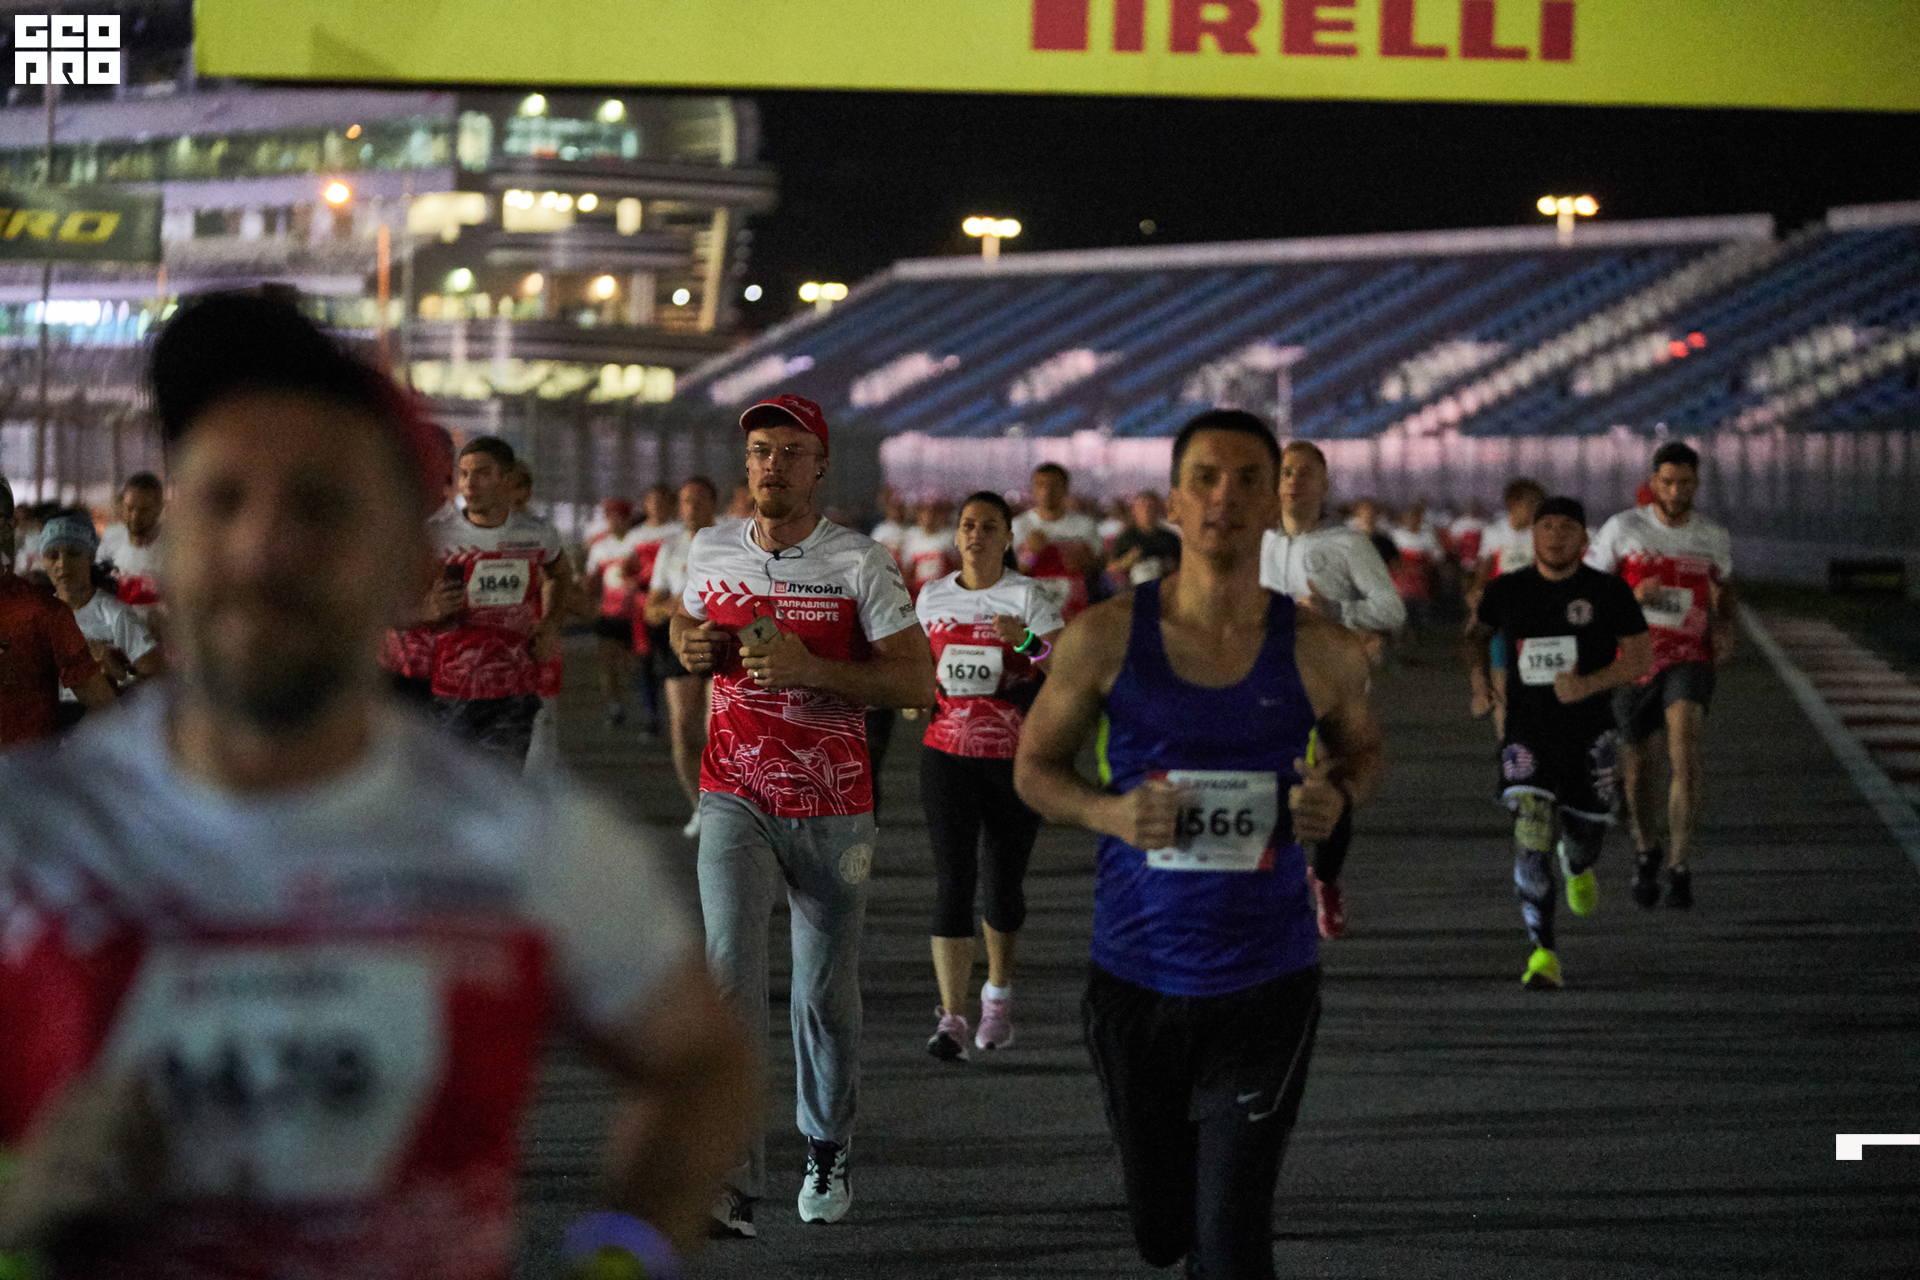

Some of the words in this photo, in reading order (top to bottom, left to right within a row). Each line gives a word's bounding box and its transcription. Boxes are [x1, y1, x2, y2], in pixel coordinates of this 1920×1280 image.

[1030, 0, 1576, 62] IRELLI
[479, 574, 520, 592] 1849
[788, 583, 842, 595] ЛУКОЙЛ
[777, 599, 839, 609] ЗАПРАВЛЯЕМ
[787, 609, 839, 621] СПОРТЕ
[1528, 653, 1565, 668] 1765
[947, 663, 990, 679] 1670
